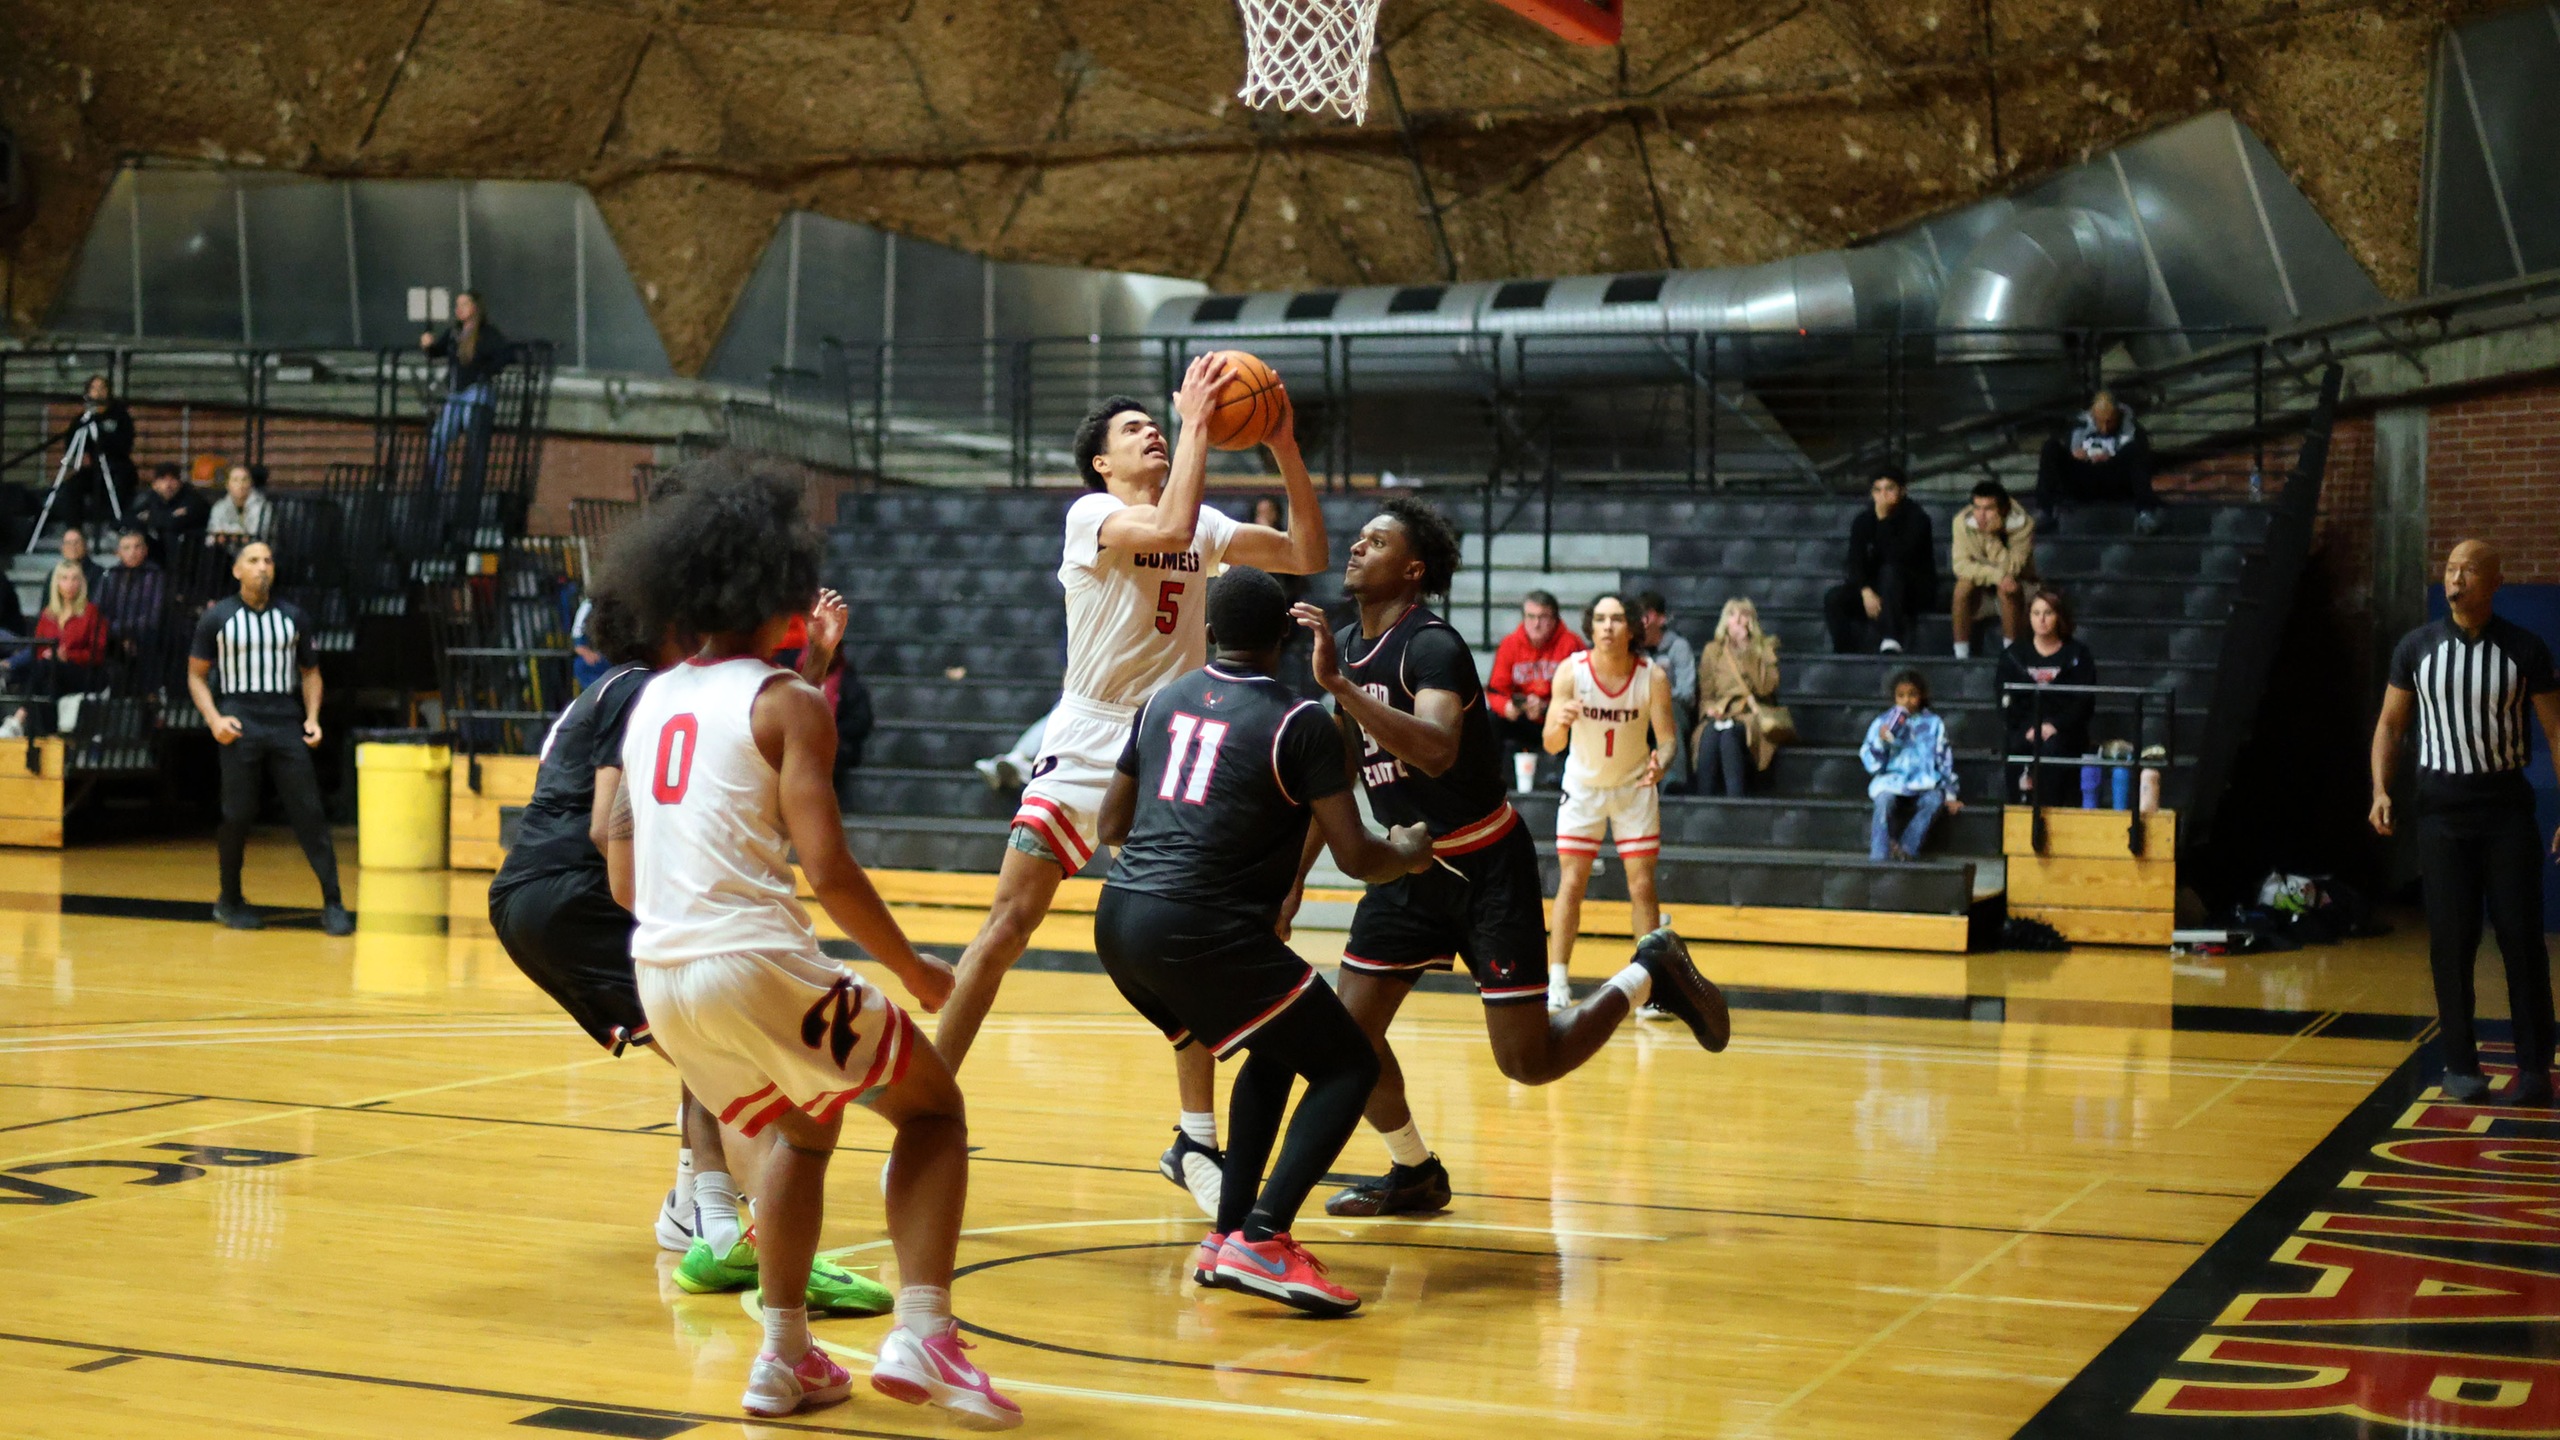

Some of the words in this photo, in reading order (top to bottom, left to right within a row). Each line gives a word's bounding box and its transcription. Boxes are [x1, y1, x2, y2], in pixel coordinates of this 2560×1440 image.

[1155, 581, 1185, 634] 5
[1582, 706, 1639, 722] COMETS
[1604, 729, 1615, 757] 1
[652, 712, 699, 805] 0
[1158, 710, 1230, 806] 11
[2130, 1041, 2560, 1438] LOMAR
